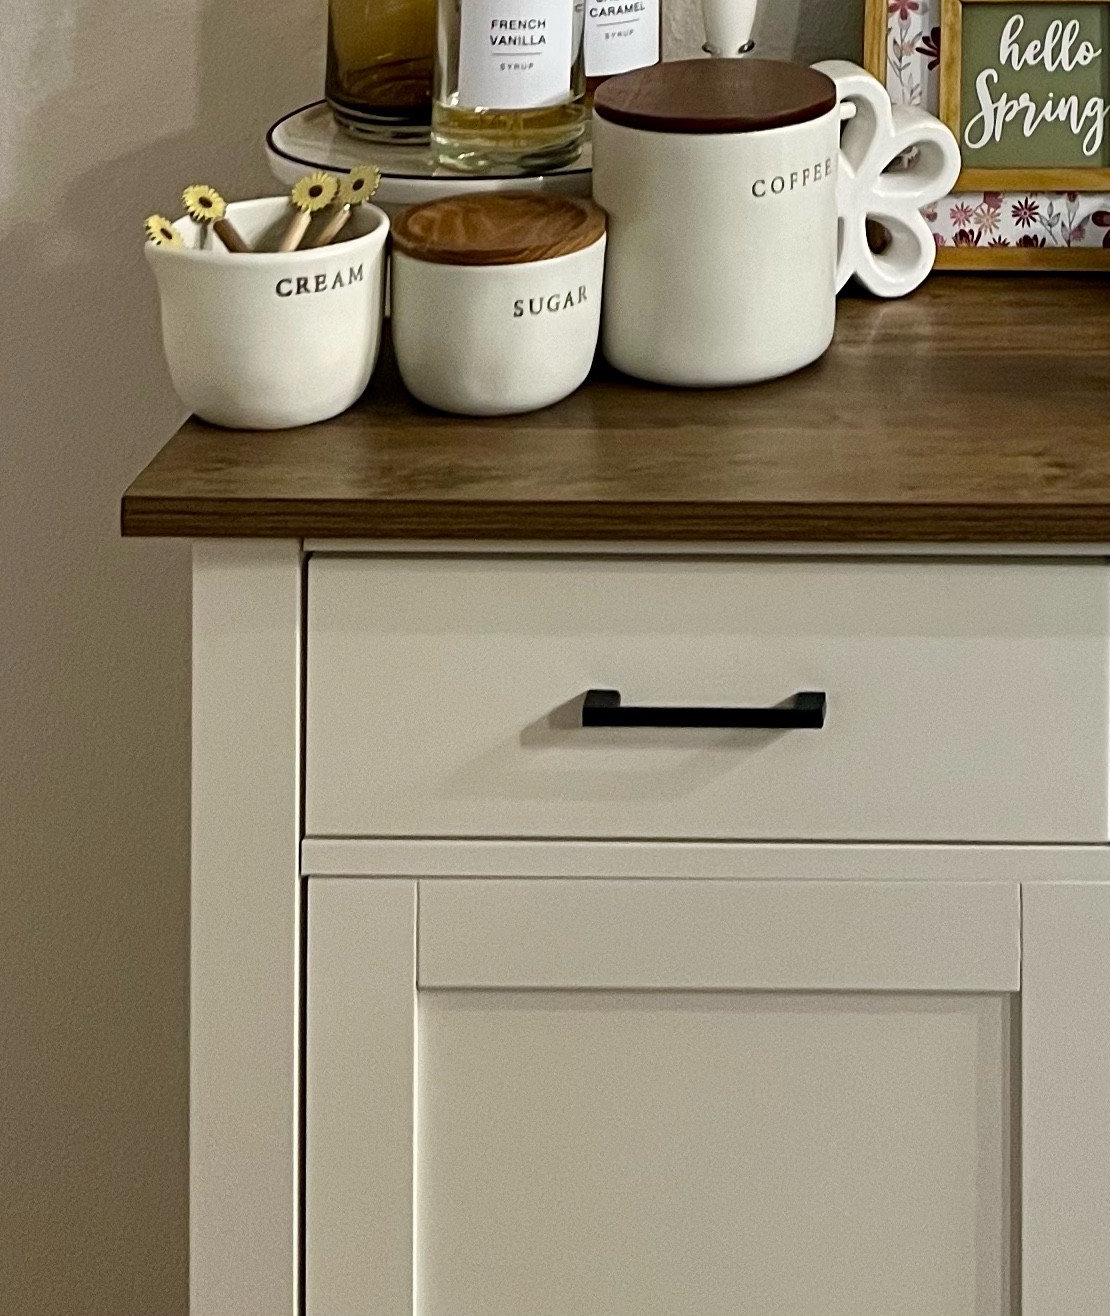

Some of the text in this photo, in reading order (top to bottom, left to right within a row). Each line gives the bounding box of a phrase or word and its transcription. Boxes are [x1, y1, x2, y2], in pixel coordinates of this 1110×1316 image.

[490, 18, 546, 30] FRENCH
[589, 1, 645, 18] CARAMEL
[489, 34, 546, 46] VANILLA
[1000, 14, 1102, 72] hello
[964, 68, 1110, 156] Spring
[751, 157, 832, 198] COFFEE
[275, 262, 365, 298] CREAM
[513, 284, 588, 318] SUGAR
